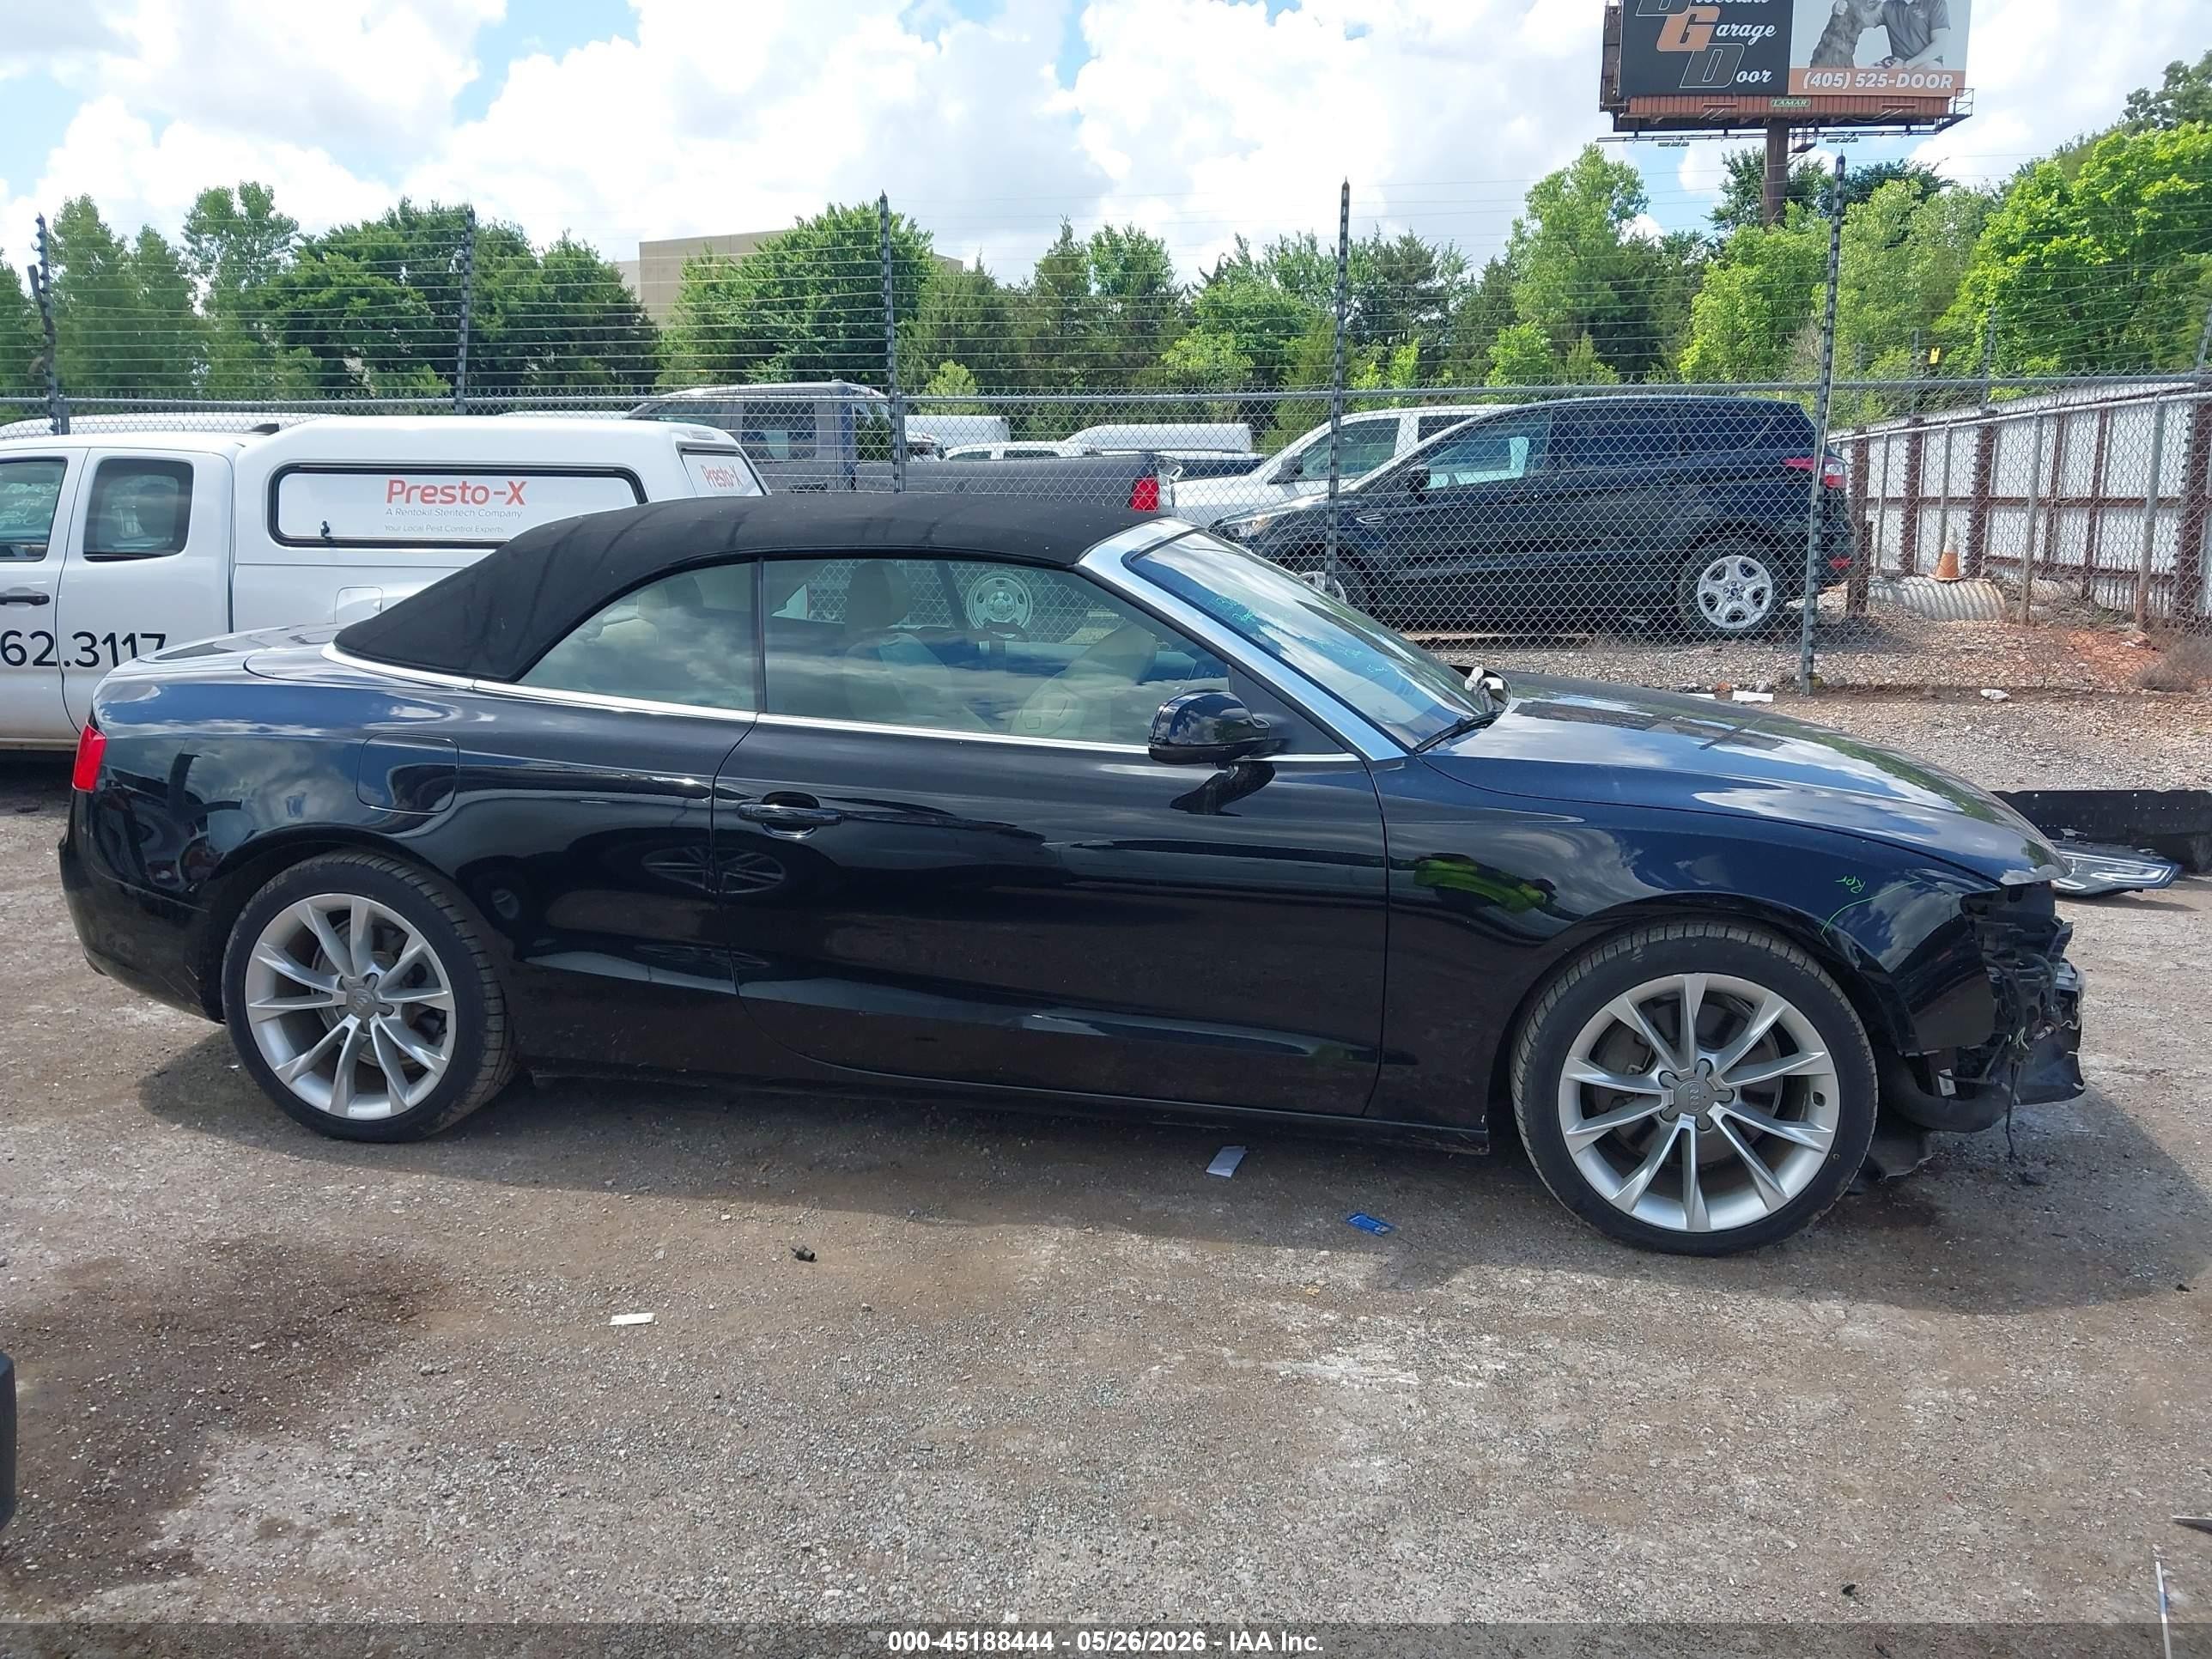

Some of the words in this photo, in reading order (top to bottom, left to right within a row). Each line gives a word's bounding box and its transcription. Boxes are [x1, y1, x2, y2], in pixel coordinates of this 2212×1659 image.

[1656, 6, 1777, 52] Garage
[1680, 43, 1772, 88] Door
[1803, 72, 1851, 89] (405)
[1855, 73, 1954, 89] 525-DOOR
[699, 465, 744, 488] Presto-X
[386, 479, 527, 505] Presto-X
[477, 509, 523, 519] Company
[445, 525, 473, 533] Control
[475, 526, 504, 534] Experts
